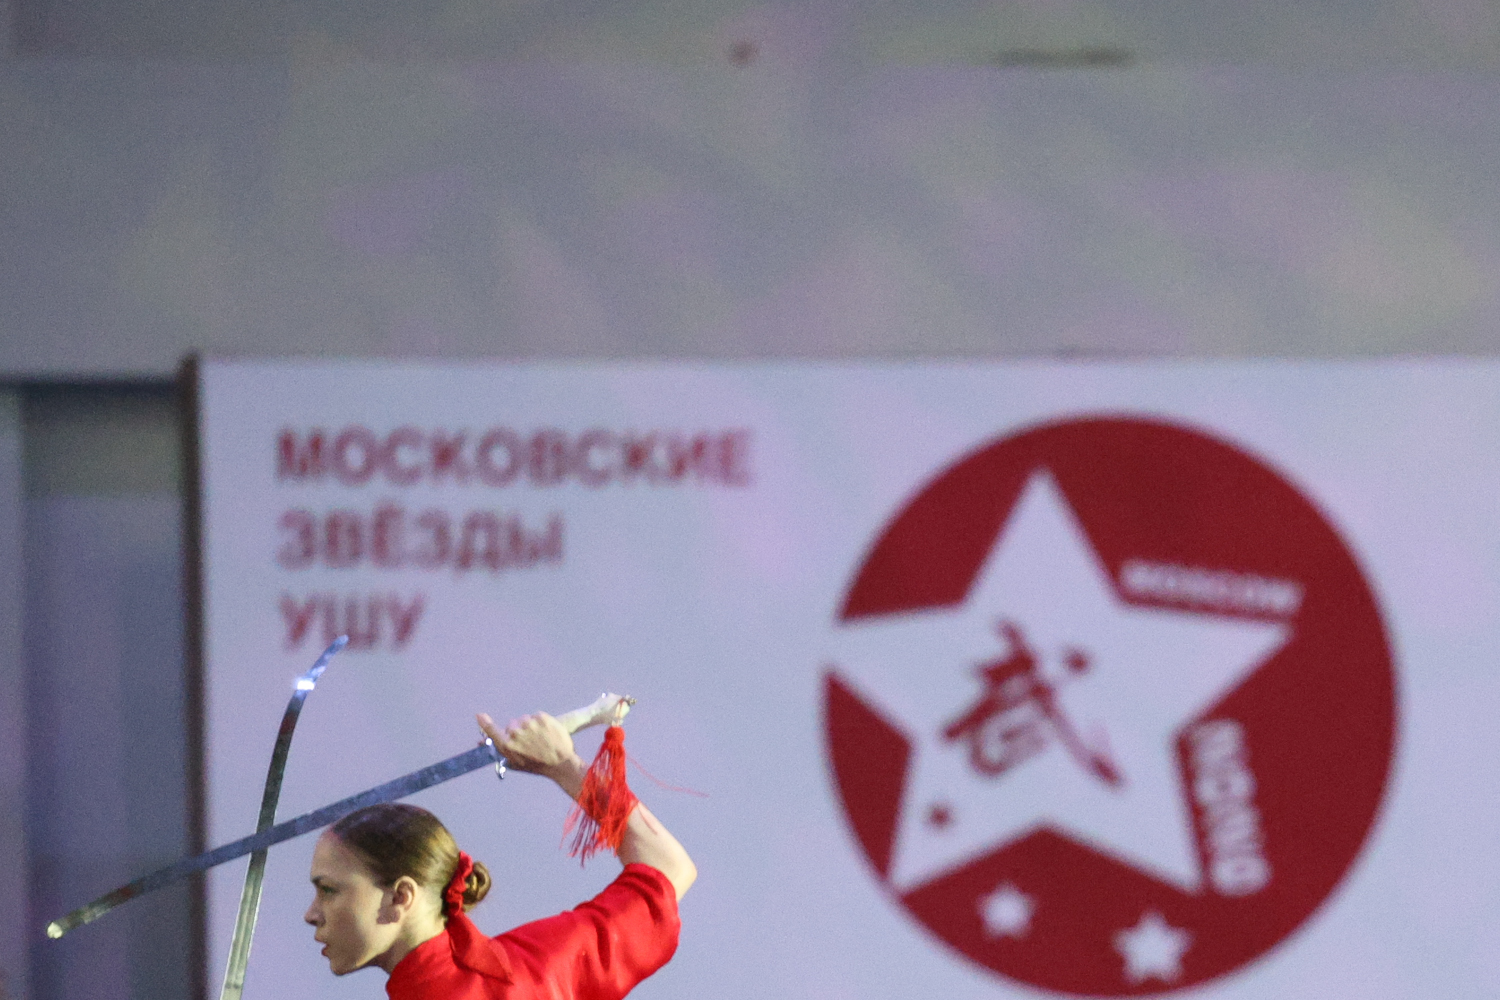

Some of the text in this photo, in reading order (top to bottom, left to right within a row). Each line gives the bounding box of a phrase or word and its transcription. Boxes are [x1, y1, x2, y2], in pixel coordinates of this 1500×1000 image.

[276, 427, 753, 487] МОСКОВСКИЕ
[276, 502, 565, 576] ЗВЁЗДЫ
[1118, 559, 1305, 614] MOSCOW
[278, 592, 427, 650] УШУ
